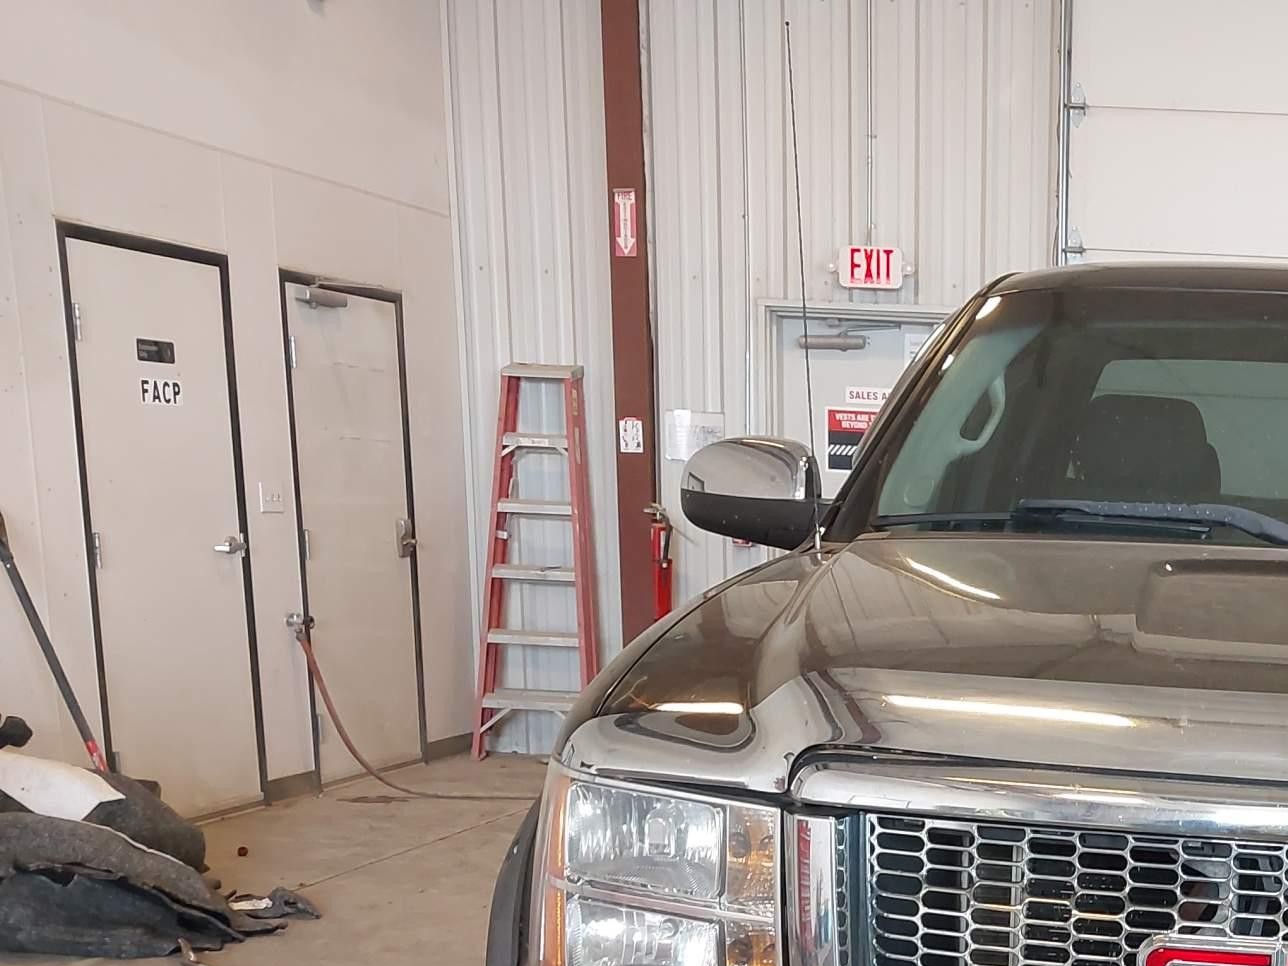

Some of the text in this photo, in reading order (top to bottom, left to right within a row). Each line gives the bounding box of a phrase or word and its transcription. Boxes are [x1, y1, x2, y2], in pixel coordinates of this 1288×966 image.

[850, 248, 894, 284] EXIT
[141, 379, 181, 405] FACP
[849, 390, 879, 401] SALES
